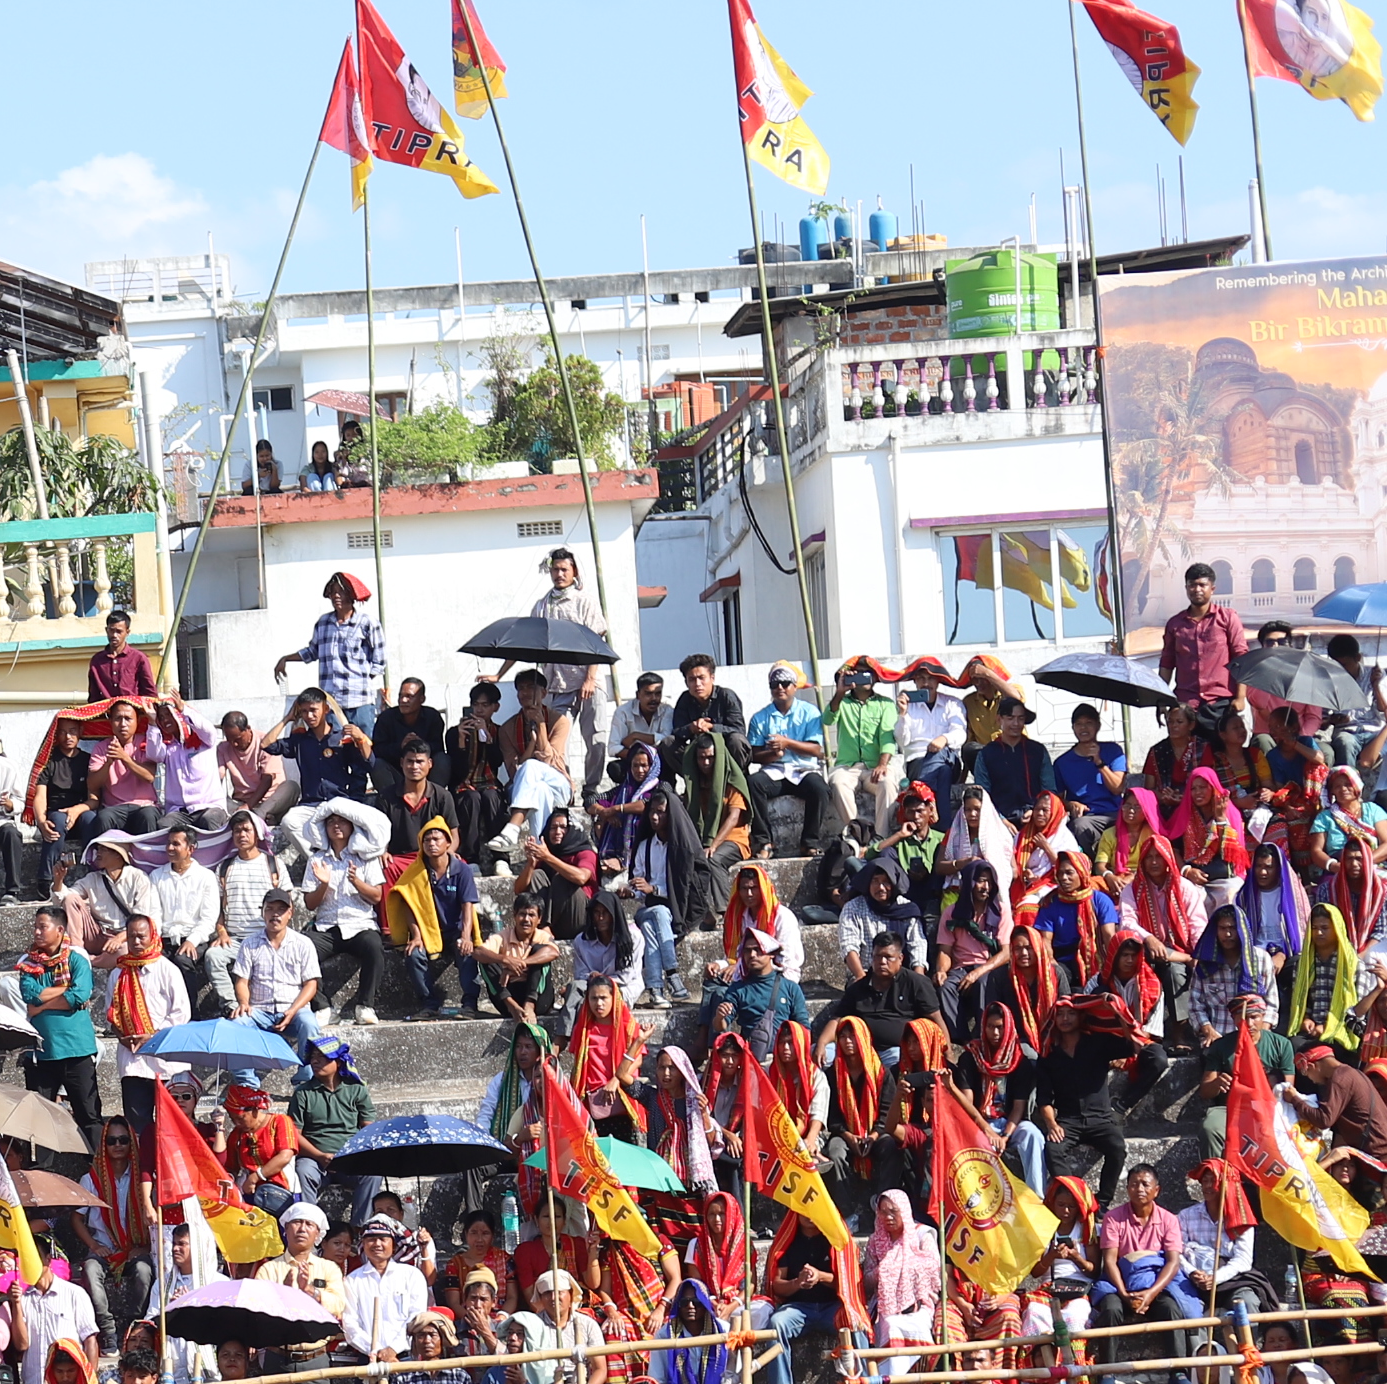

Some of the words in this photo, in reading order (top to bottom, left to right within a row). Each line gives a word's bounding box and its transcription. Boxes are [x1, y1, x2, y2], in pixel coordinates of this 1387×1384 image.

[1216, 271, 1316, 290] Remembering
[1321, 267, 1346, 282] the
[1350, 263, 1387, 280] Archi
[1317, 284, 1387, 310] Maha
[1248, 319, 1289, 342] Bir
[945, 1211, 986, 1264] ISF
